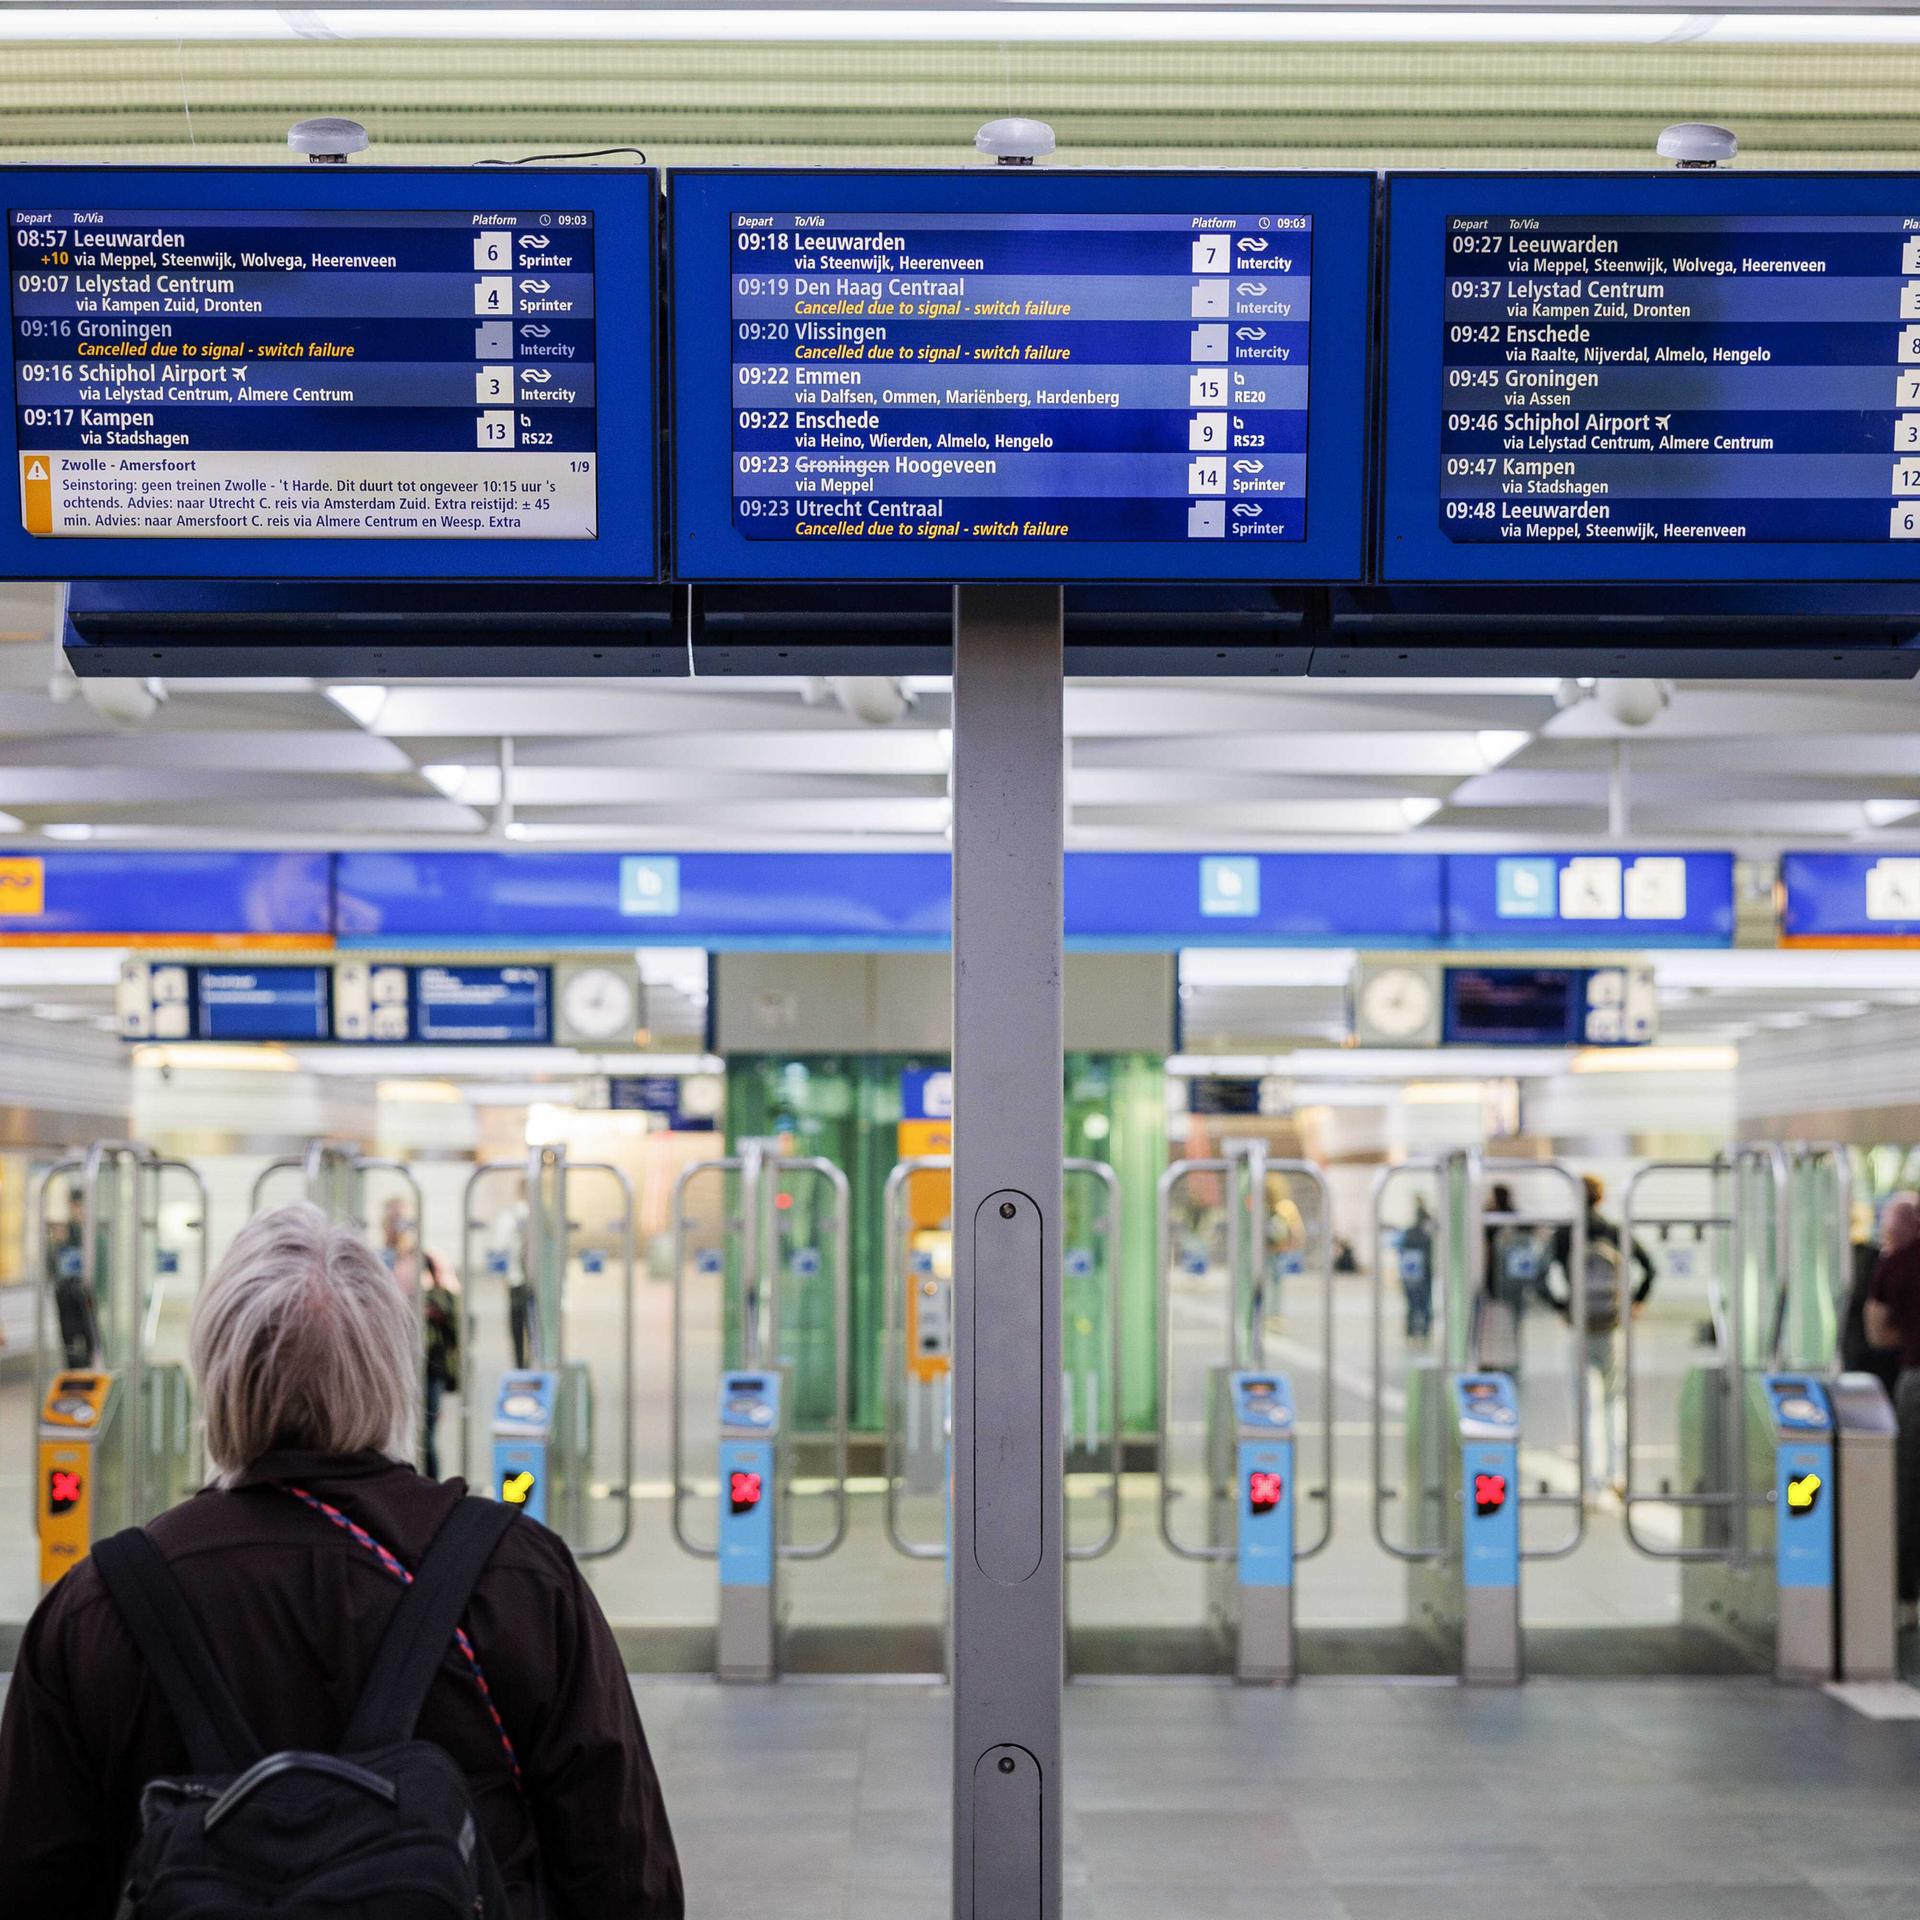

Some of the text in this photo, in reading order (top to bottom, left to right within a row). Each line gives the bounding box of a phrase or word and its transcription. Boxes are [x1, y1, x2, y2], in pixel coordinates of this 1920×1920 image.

[16, 211, 104, 226] Depart To/Via
[472, 214, 517, 225] Platform
[558, 215, 587, 226] 09:03
[1191, 216, 1236, 229] Platform
[1277, 217, 1306, 229] 09:03
[17, 228, 185, 248] 08:57 Leeuwarden
[738, 231, 905, 251] 09:18 Leeuwarden
[1453, 234, 1618, 253] 09:27 Leeuwarden
[41, 251, 69, 265] +10
[74, 251, 397, 271] via Meppel, Steenwijk, Wolvega, Heerenveen
[488, 244, 498, 261] 6
[519, 253, 573, 268] Sprinter
[1206, 247, 1216, 264] 7
[794, 254, 984, 274] via Steenwijk, Heerenveen
[1237, 256, 1292, 273] Intercity
[19, 273, 234, 297] 09:07 Lelystad Centrum
[738, 277, 964, 301] 09:19 Den Haag Centraal
[76, 297, 262, 315] via Kampen Zuid, Dronten
[488, 289, 499, 306] 4
[519, 298, 573, 314] Sprinter
[21, 319, 172, 342] 09:16 Groningen
[739, 321, 886, 345] 09:20 Vlissingen
[1450, 324, 1590, 343] 09:42 Enschede
[78, 341, 148, 356] Cancelled
[151, 341, 178, 356] due
[182, 343, 197, 356] to
[201, 341, 245, 360] signal
[257, 342, 304, 357] switch
[308, 342, 355, 357] failure
[1505, 346, 1771, 365] via Raalte, Nijverdal, Almelo, Hengelo
[22, 363, 227, 387] 09:16 Schiphol Airport
[739, 367, 861, 385] 09:22 Emmen
[1449, 368, 1599, 391] 09:45 Groningen
[79, 386, 353, 404] via Lelystad Centrum, Almere Centrum
[490, 378, 500, 395] 3
[521, 387, 576, 404] Intercity
[1200, 381, 1219, 398] 15
[795, 388, 1120, 408] via Dalfsen, Ommen, Mariënberg, Hardenberg
[1235, 390, 1266, 403] RE20
[1504, 391, 1571, 406] via Assen
[24, 408, 154, 430] 09:17 Kampen
[739, 410, 879, 429] 09:22 Enschede
[81, 430, 189, 448] via Stadshagen
[486, 423, 506, 440] 13
[522, 432, 553, 445] RS22
[1203, 425, 1213, 442] 9
[1234, 434, 1265, 447] RS23
[795, 433, 1053, 452] via Heino, Wierden, Almelo, Hengelo
[61, 458, 106, 471] Zwolle
[119, 458, 196, 471] Amersfoort
[570, 461, 590, 473] 1/9
[739, 455, 996, 478] 09:23 Groningen Hoogeveen
[795, 477, 873, 496] via Meppel
[1198, 469, 1218, 486] 14
[1233, 478, 1286, 493] Sprinter
[62, 478, 137, 495] Seinstoring:
[141, 481, 172, 494] geen
[176, 478, 221, 491] treinen
[225, 478, 267, 492] Zwolle
[279, 478, 289, 492] 't
[292, 479, 333, 492] Harde.
[337, 479, 355, 492] Dit
[359, 479, 393, 492] duurt
[397, 480, 416, 492] tot
[419, 482, 479, 496] ongeveer
[483, 480, 517, 493] 10:15
[521, 483, 542, 493] uur
[546, 479, 556, 493] 's
[63, 495, 550, 514] ochtends. Advies: naar Utrecht C. reis via Amsterdam Zuid. Extra reistijd: ± 45
[740, 498, 943, 517] 09:23 Utrecht Centraal
[1446, 500, 1610, 519] 09:48 Leeuwarden
[64, 513, 521, 531] min. Advies: naar Amersfoort C. reis via Almere Centrum en Weesp. Extra
[1904, 514, 1914, 530] 6
